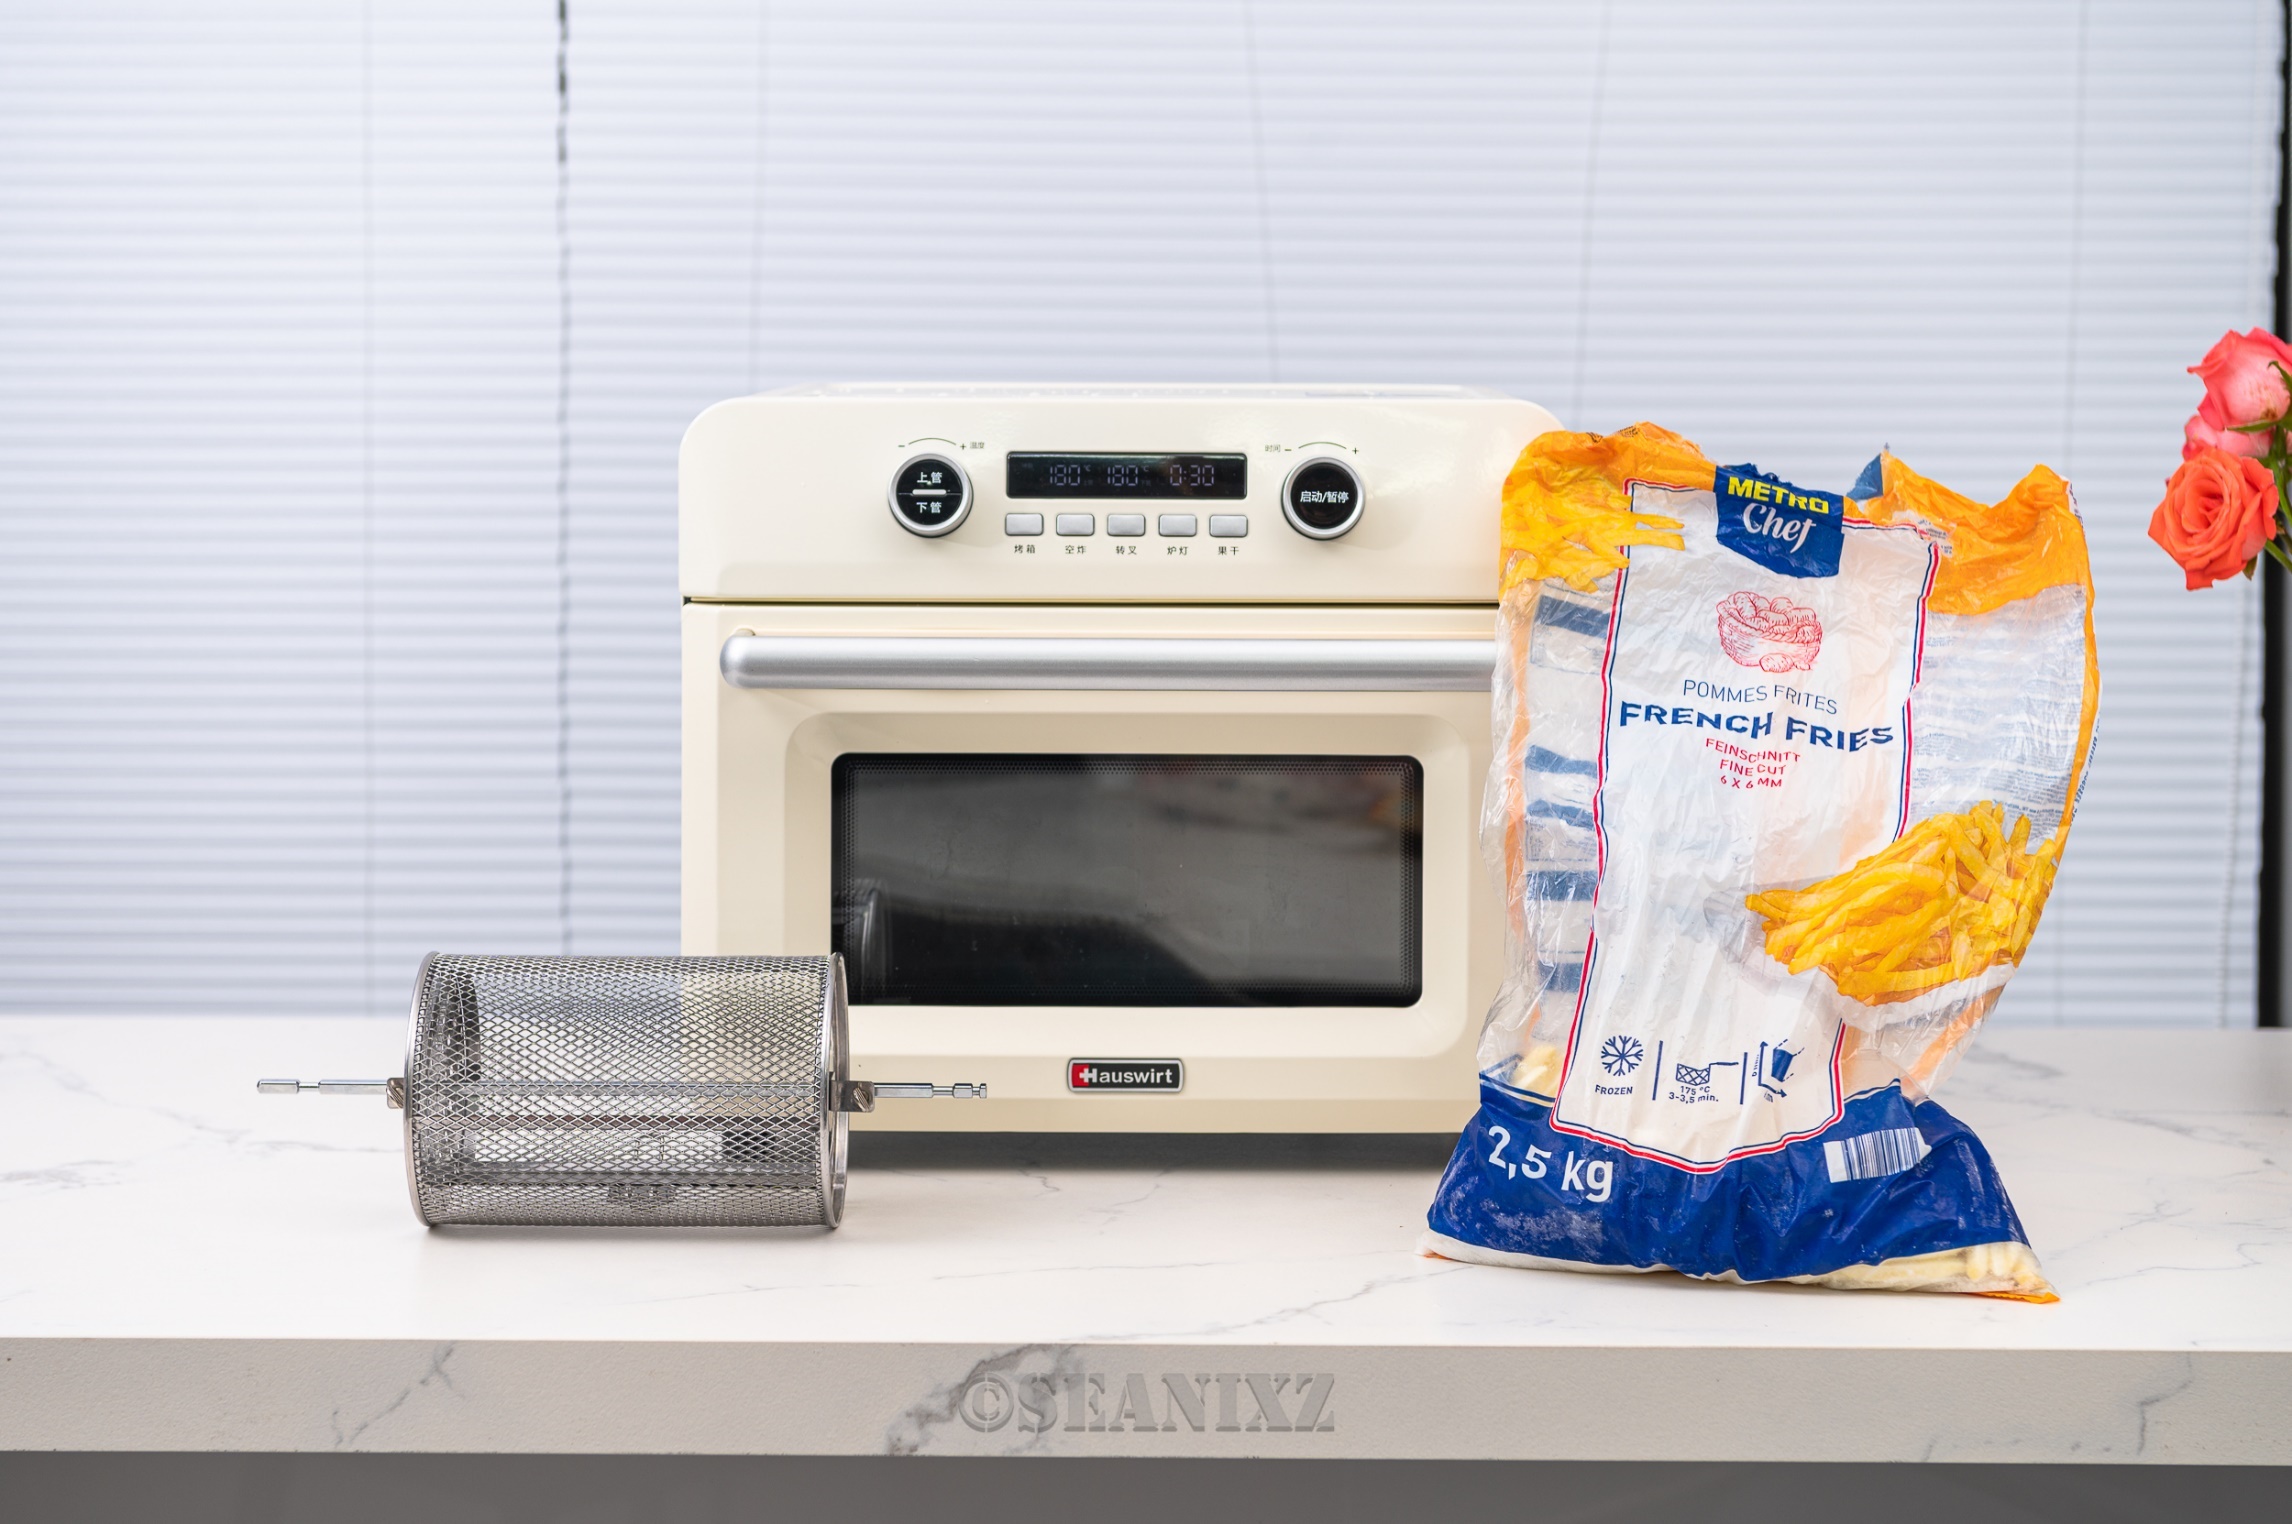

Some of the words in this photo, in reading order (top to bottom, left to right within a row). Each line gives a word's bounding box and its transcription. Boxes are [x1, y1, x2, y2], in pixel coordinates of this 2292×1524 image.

[916, 471, 943, 484] 上管
[1049, 464, 1081, 486] 180
[1107, 465, 1138, 486] 180
[1169, 464, 1215, 487] 0:30
[1300, 490, 1349, 504] 启动/暂停
[1727, 476, 1829, 514] METRO
[916, 502, 942, 514] 下管
[1742, 502, 1817, 554] Chef
[1014, 544, 1036, 554] 烤箱
[1065, 545, 1087, 554] 空炸
[1115, 545, 1137, 555] 转叉
[1167, 546, 1189, 556] 炉灯
[1218, 546, 1240, 556] 果干
[1683, 679, 1768, 703] POMMES
[1773, 684, 1838, 715] FRITES
[1620, 701, 1774, 739] FRENCH
[1785, 716, 1894, 752] FRIES
[1705, 737, 1801, 763] FEINSCHNITT
[1719, 759, 1753, 777] FINE
[1757, 763, 1787, 775] CUT
[1720, 775, 1727, 785] 6
[1745, 780, 1754, 789] 6
[1757, 777, 1783, 788] MM
[1080, 1068, 1173, 1083] Hauswirt
[1595, 1084, 1634, 1095] FROZEN
[1680, 1085, 1697, 1095] 175
[1697, 1093, 1719, 1102] min.
[1488, 1125, 1552, 1180] 2,5
[1561, 1150, 1614, 1203] kg
